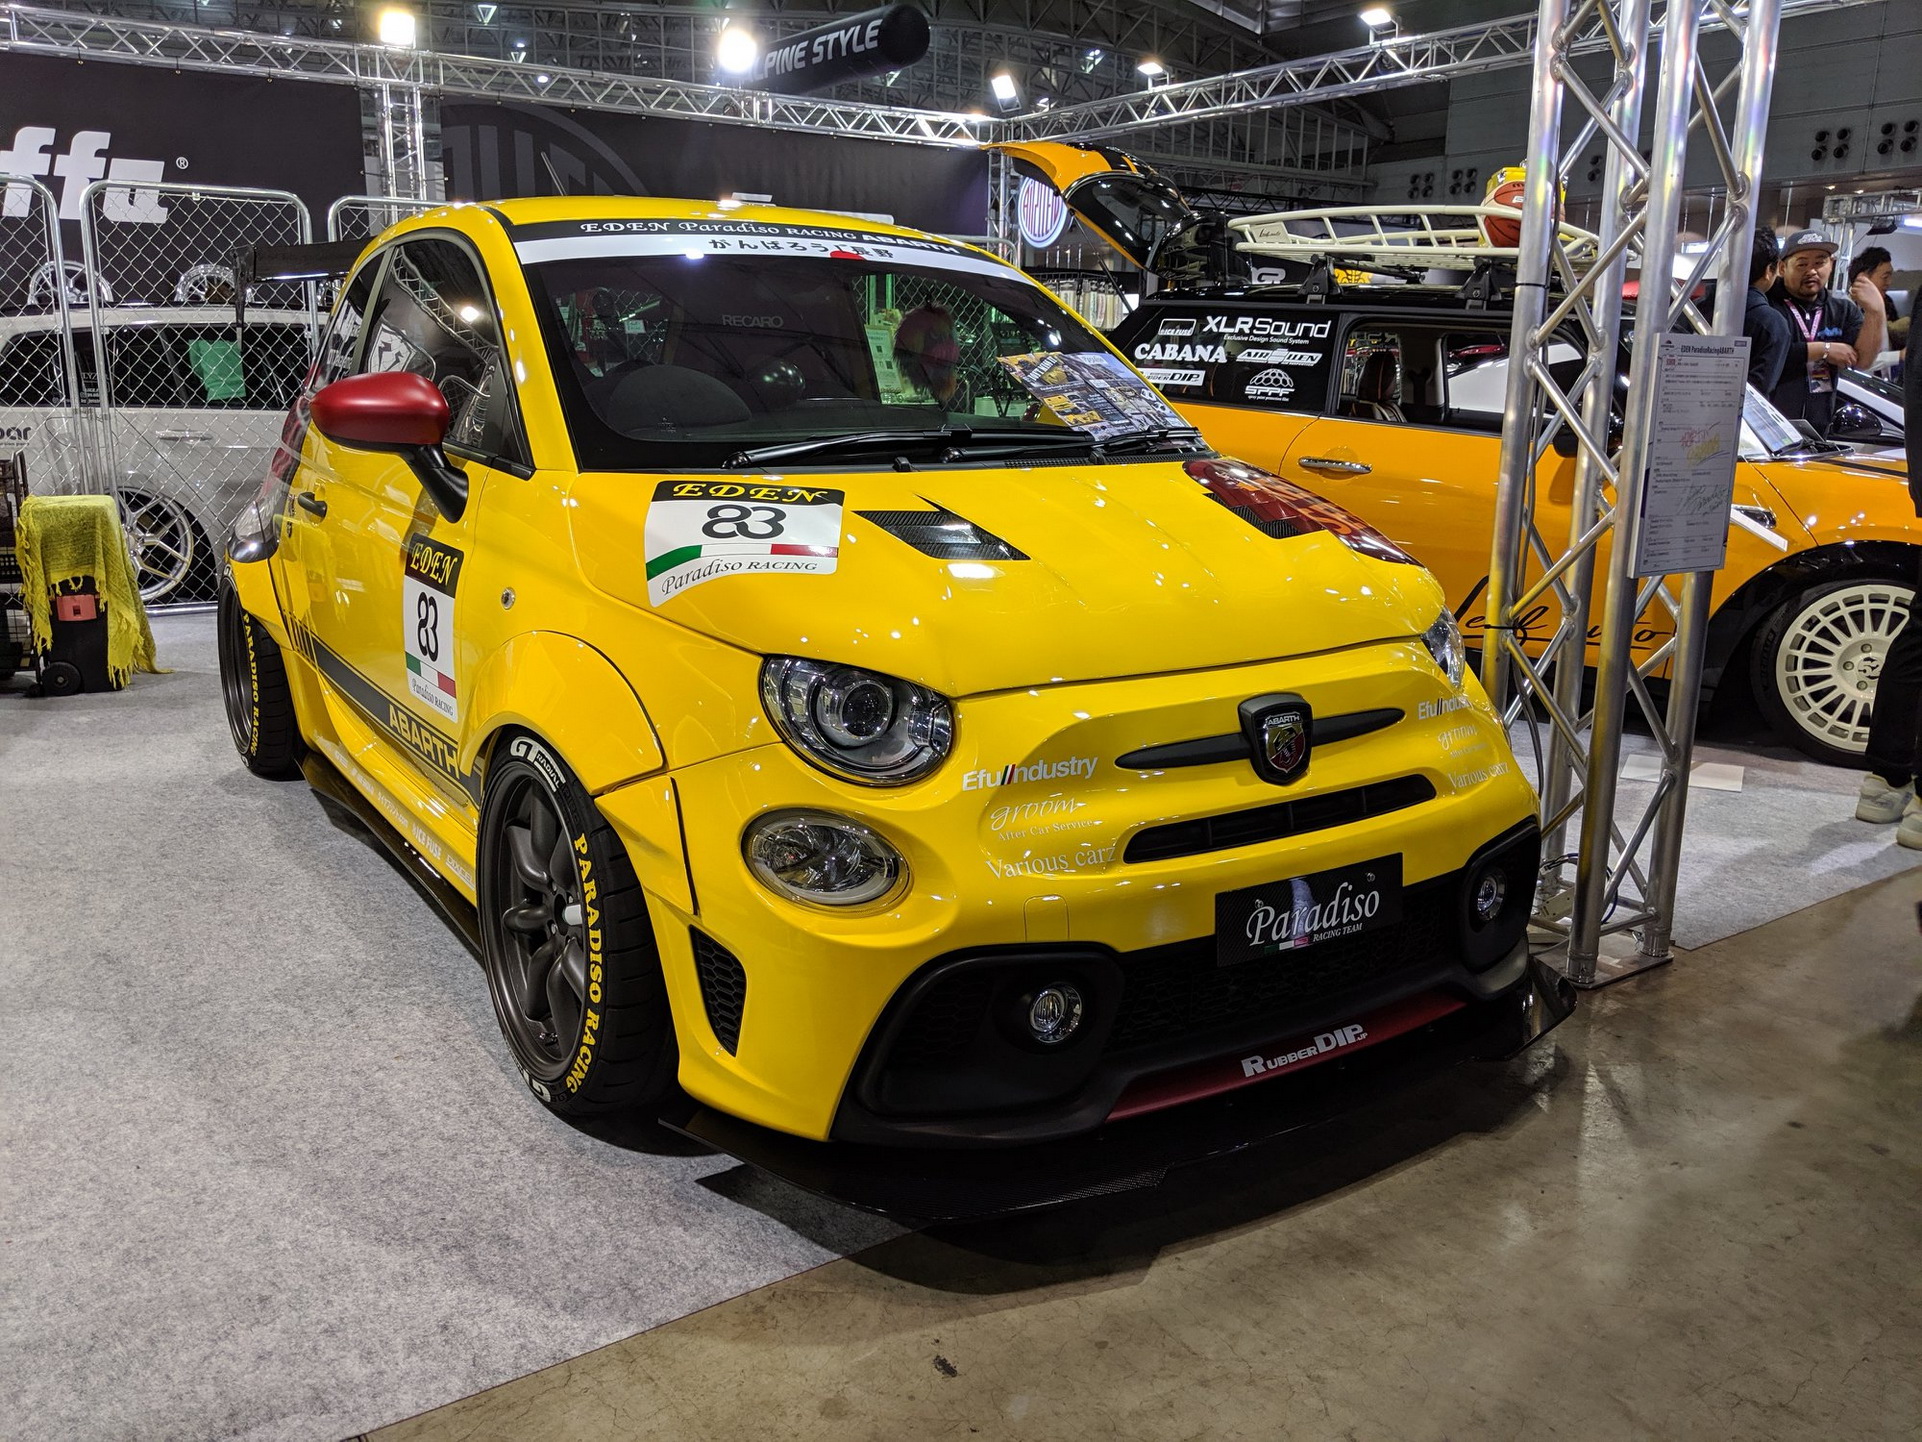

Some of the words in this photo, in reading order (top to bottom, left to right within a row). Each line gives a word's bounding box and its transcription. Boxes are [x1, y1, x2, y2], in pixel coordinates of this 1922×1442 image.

[812, 18, 883, 65] STYLE
[580, 222, 670, 233] EDEN
[678, 222, 779, 234] Paradiso
[785, 228, 856, 240] RACING
[861, 234, 960, 254] ABARTH
[722, 314, 784, 328] RECARO
[1134, 342, 1228, 363] CABANA
[1224, 333, 1248, 342] Exclusive
[1249, 336, 1269, 344] Design
[1245, 386, 1296, 397] SPPF
[673, 483, 828, 503] EDEN
[702, 504, 787, 539] 83
[410, 542, 458, 586] EDEN
[661, 558, 743, 595] Paradiso
[746, 561, 818, 571] RACING
[417, 591, 439, 662] 83
[243, 613, 260, 703] PARADISO
[434, 694, 454, 716] RACING
[1268, 715, 1300, 725] ABARTH
[250, 706, 260, 756] RACING
[389, 704, 460, 779] ABARTH
[535, 753, 561, 788] RADIAL
[1448, 768, 1489, 789] Various
[990, 797, 1079, 831] groom
[998, 830, 1027, 842] After
[1029, 825, 1050, 836] Car
[1053, 819, 1093, 832] Service
[985, 855, 1069, 879] Various
[1075, 847, 1117, 867] carz
[574, 833, 604, 1003] PARADISO
[1246, 881, 1380, 946] Paradiso
[1312, 928, 1341, 942] RACING
[1342, 922, 1363, 935] TEAM
[566, 1008, 600, 1093] RACING
